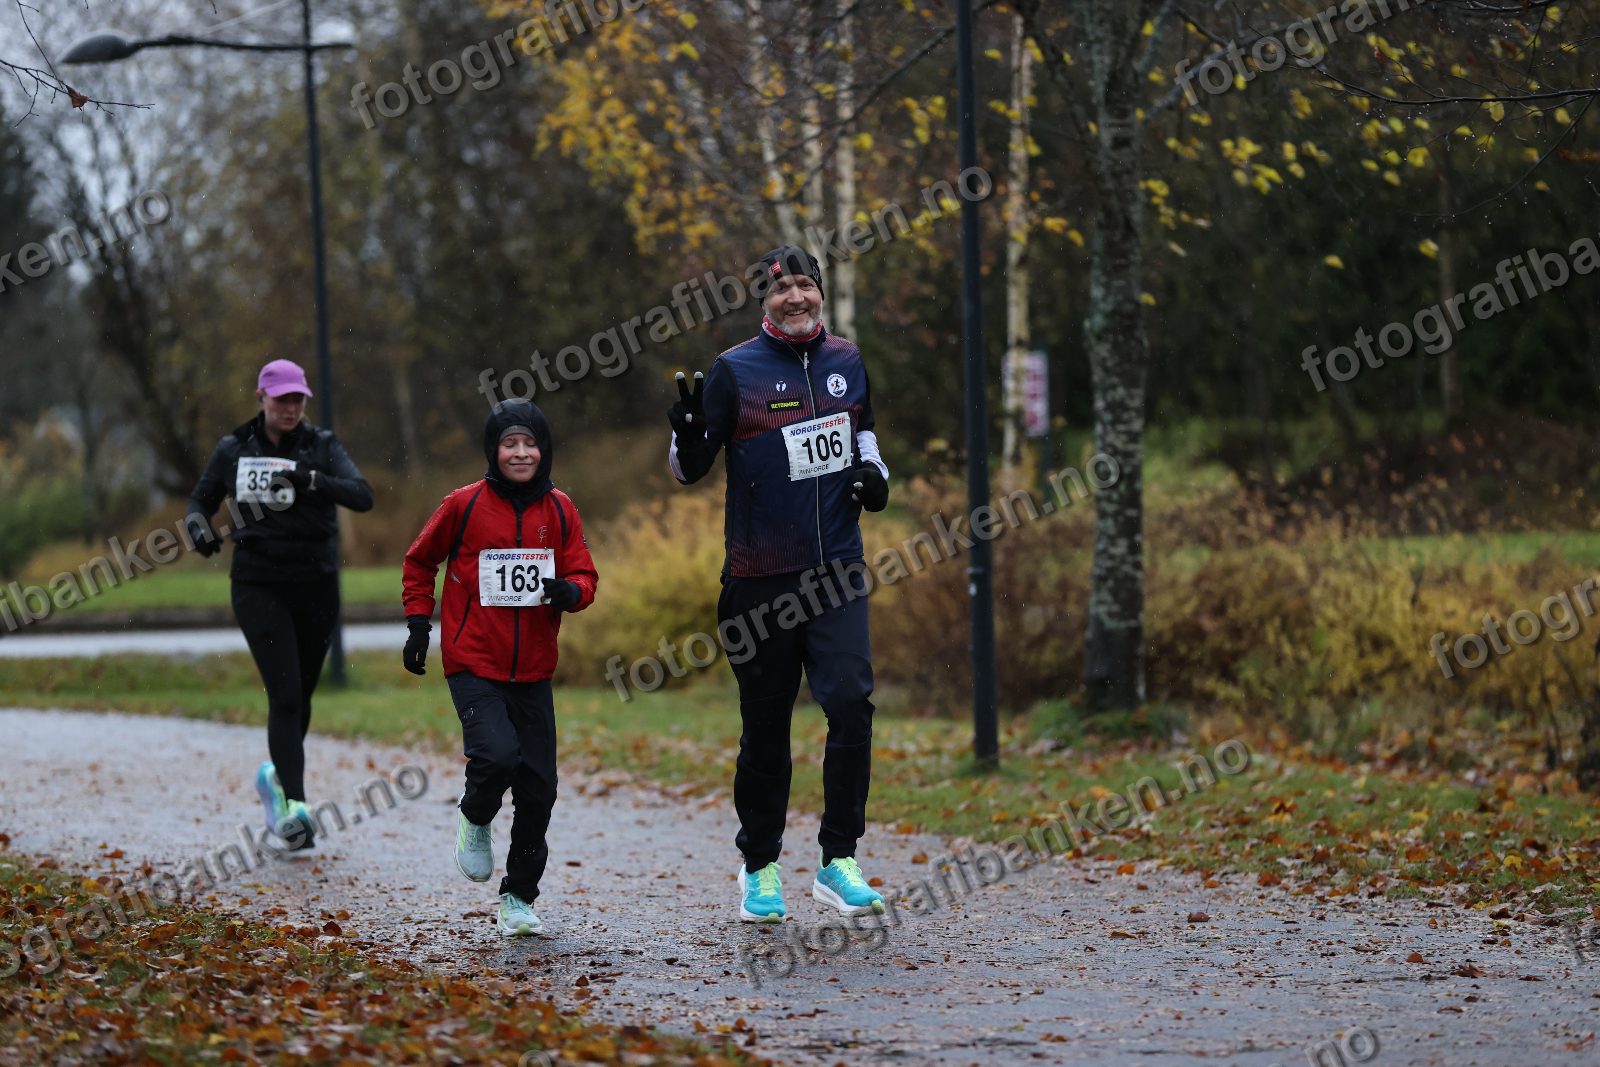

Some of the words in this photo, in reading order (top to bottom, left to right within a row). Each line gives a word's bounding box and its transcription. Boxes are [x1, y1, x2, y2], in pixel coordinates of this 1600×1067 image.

[801, 430, 843, 464] 106
[247, 469, 282, 491] 35
[486, 553, 550, 561] NORGESTESTEN
[495, 564, 540, 593] 163
